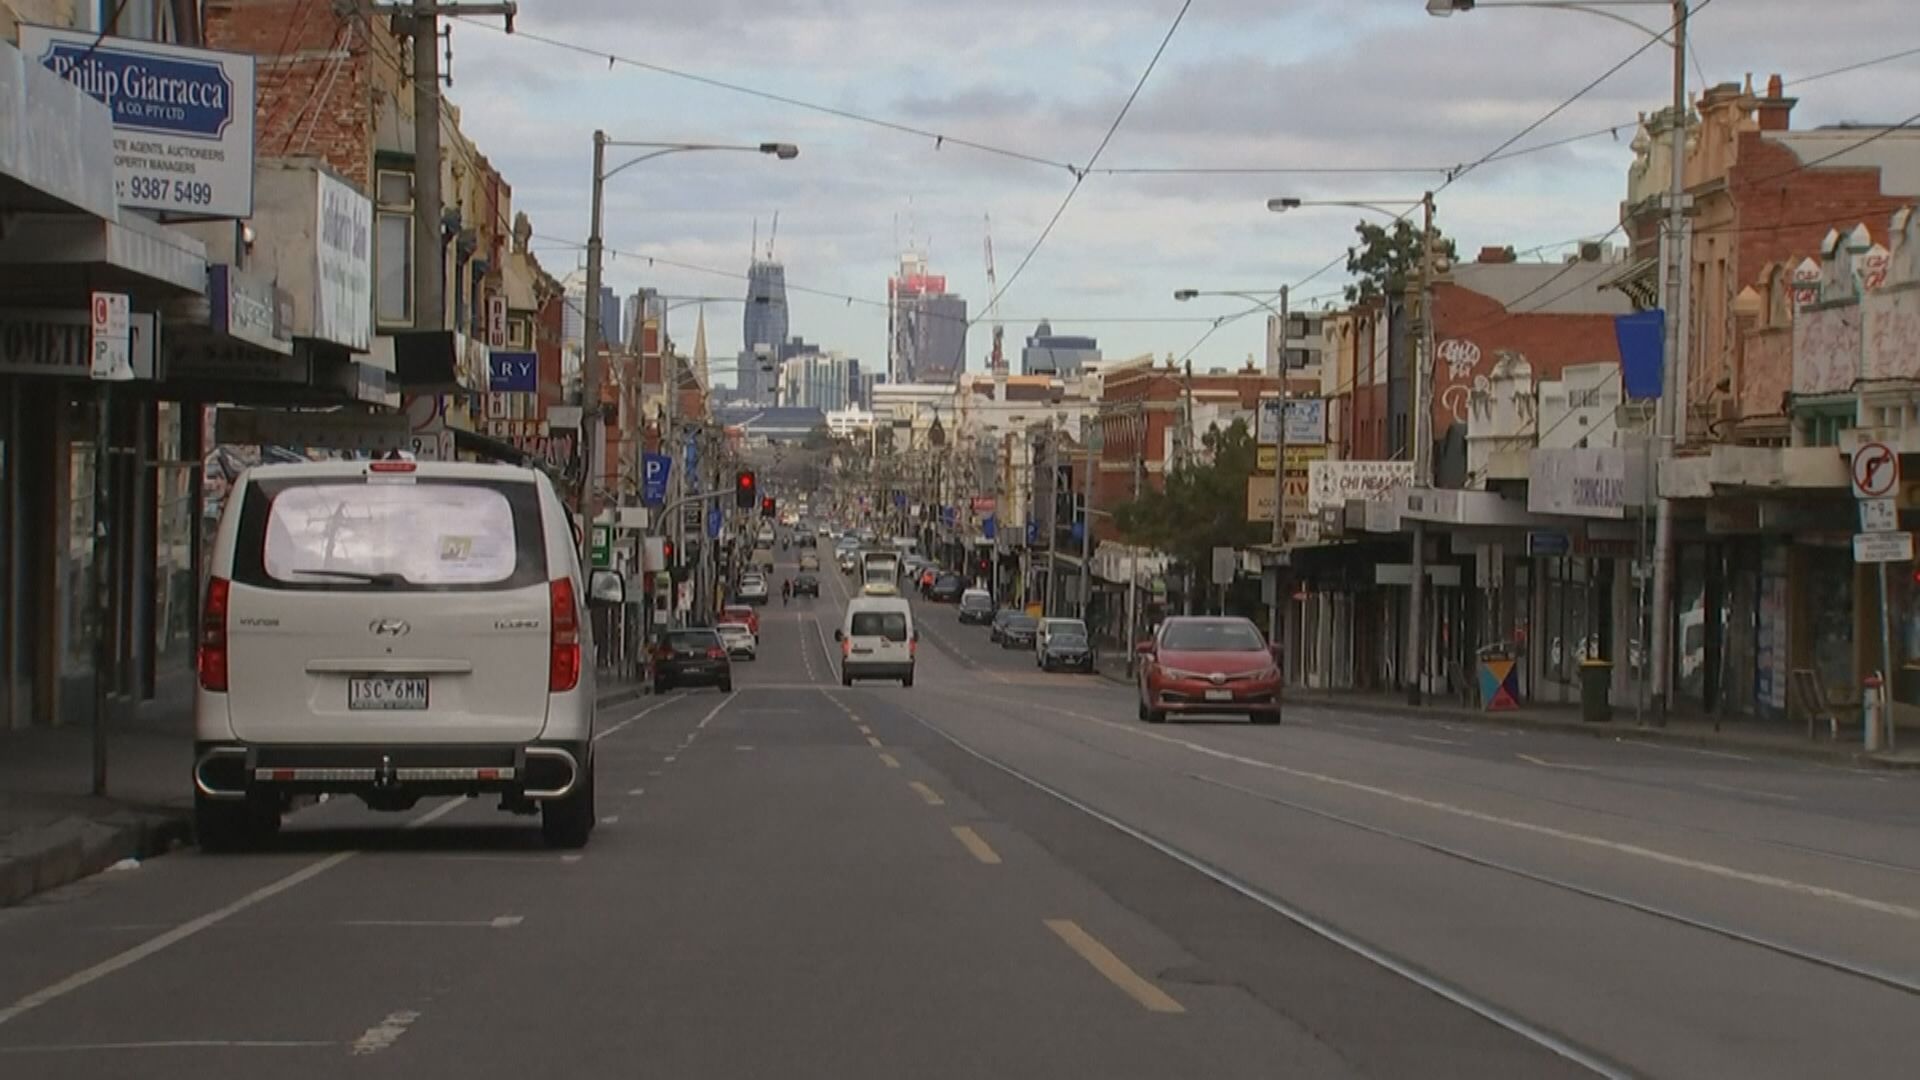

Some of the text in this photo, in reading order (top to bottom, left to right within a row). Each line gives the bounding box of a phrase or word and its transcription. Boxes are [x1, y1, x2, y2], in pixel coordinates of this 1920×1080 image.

[122, 64, 224, 109] Giarracca
[166, 144, 225, 162] AUCTIONEERS
[149, 159, 196, 174] MANAGERS
[130, 175, 170, 200] 9387
[174, 181, 212, 205] 5499
[647, 461, 661, 480] P
[395, 682, 425, 698] 6MN
